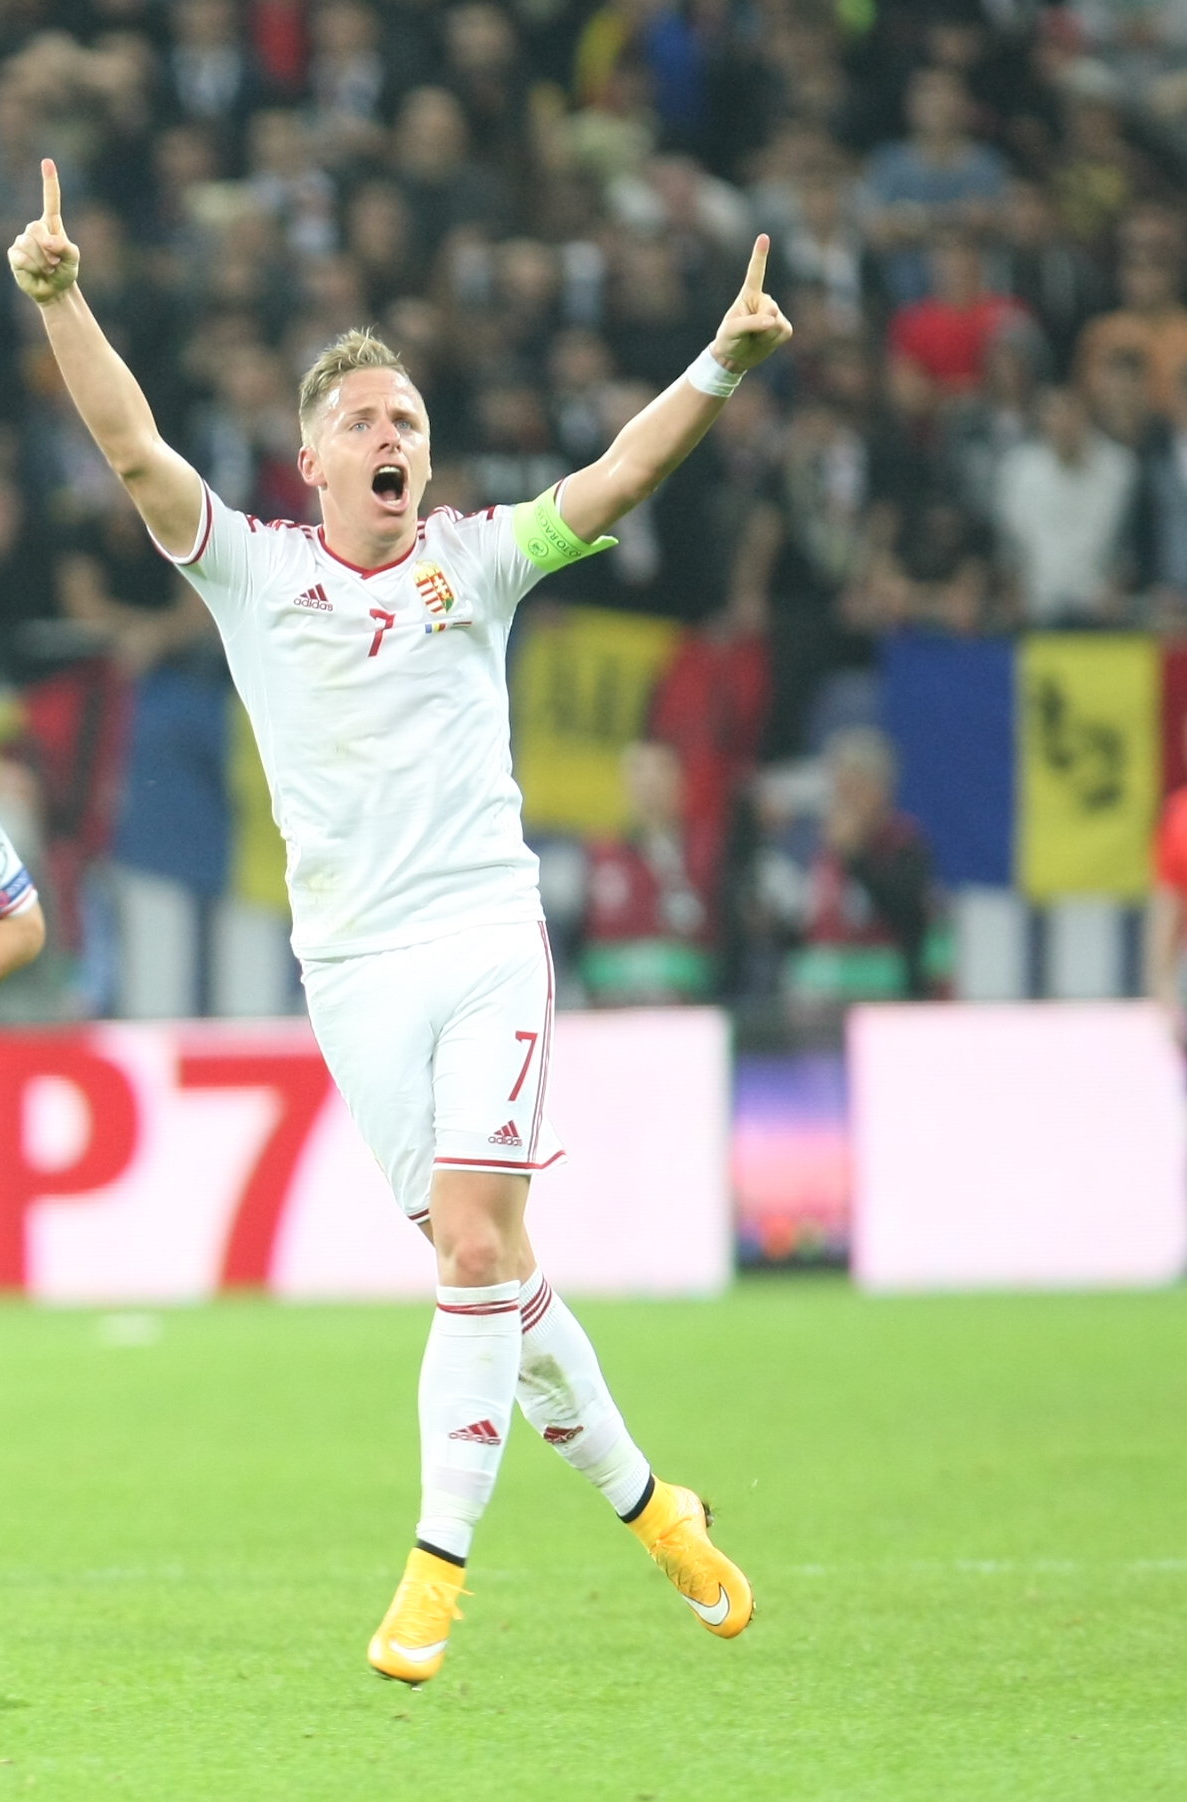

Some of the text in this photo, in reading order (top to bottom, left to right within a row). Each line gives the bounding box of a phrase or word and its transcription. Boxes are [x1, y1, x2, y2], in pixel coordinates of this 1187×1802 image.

[293, 597, 334, 612] adidas
[368, 608, 396, 657] 7
[508, 1030, 538, 1102] 7
